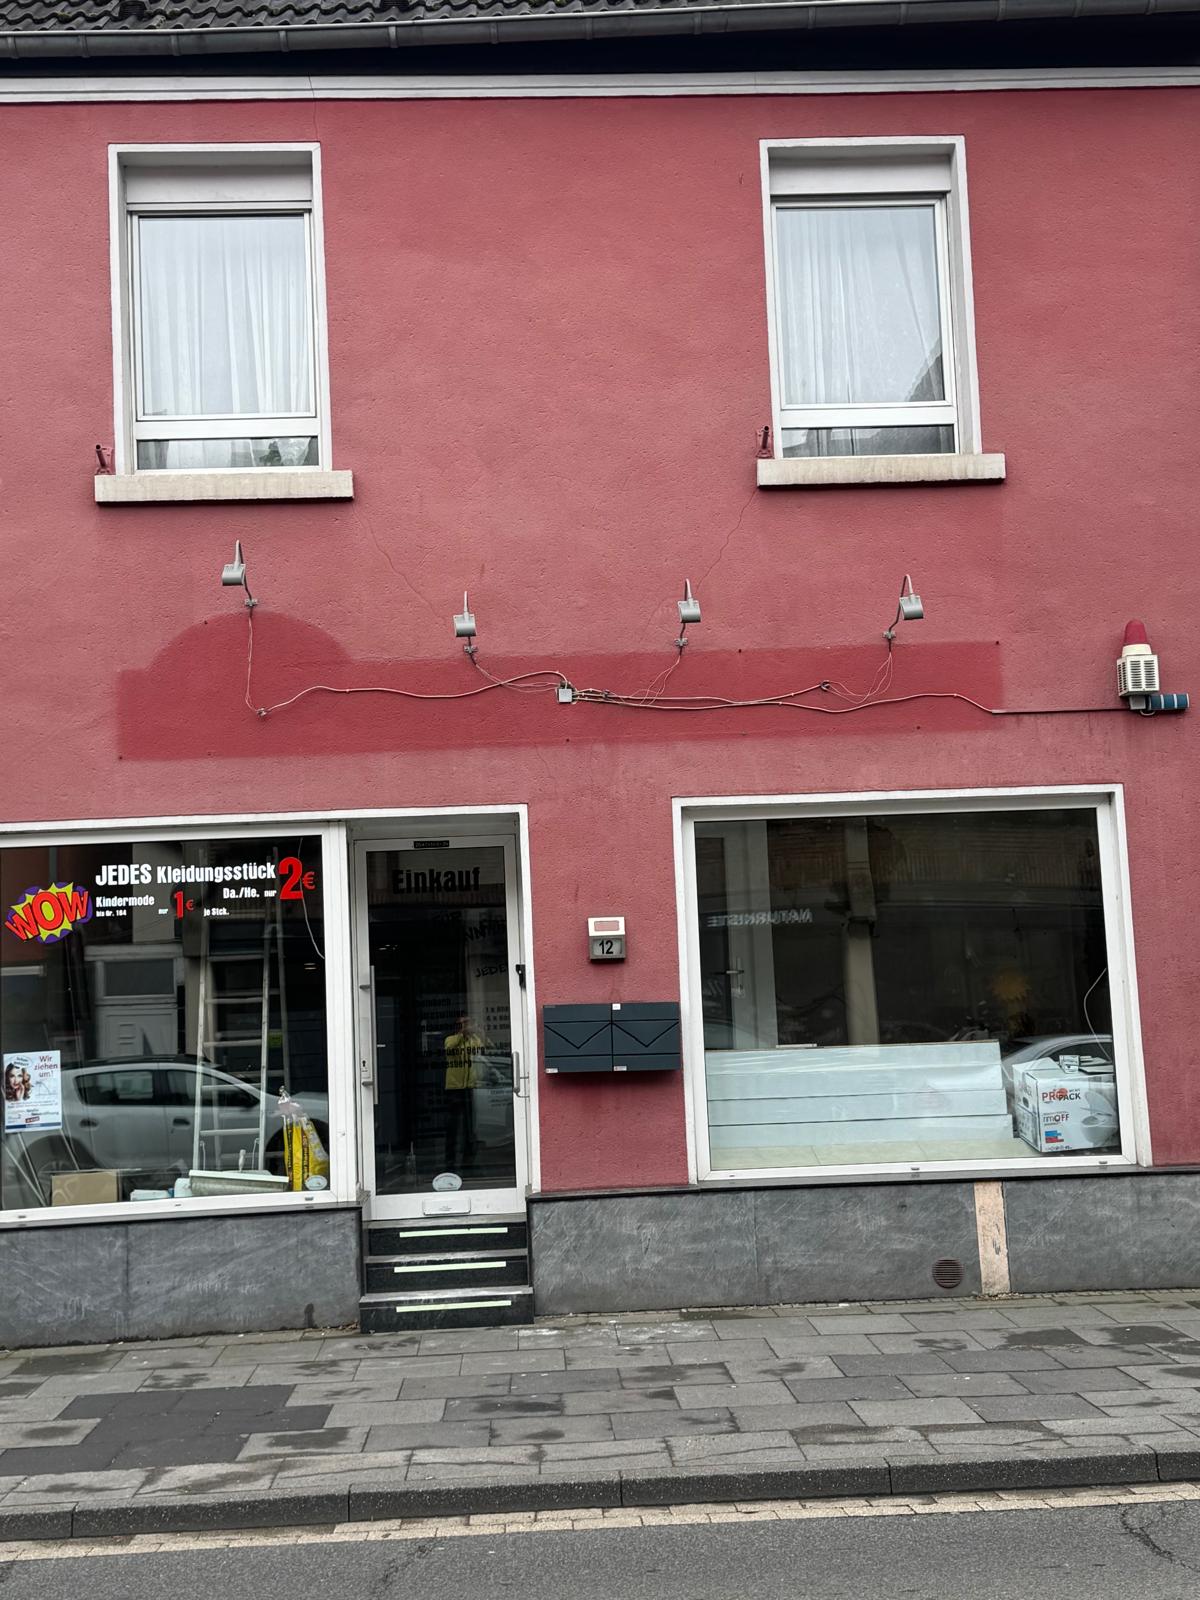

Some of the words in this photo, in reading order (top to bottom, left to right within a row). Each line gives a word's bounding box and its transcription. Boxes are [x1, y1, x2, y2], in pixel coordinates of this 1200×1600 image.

[95, 864, 152, 886] JEDES
[156, 862, 276, 883] Kleidungsstück
[392, 866, 481, 895] Einkauf
[223, 887, 260, 899] Da./He.
[96, 895, 155, 908] Kindermode
[4, 891, 89, 942] WOW
[599, 940, 614, 955] 12
[39, 1055, 53, 1063] Wir
[34, 1063, 58, 1071] ziehen
[39, 1070, 54, 1078] um!
